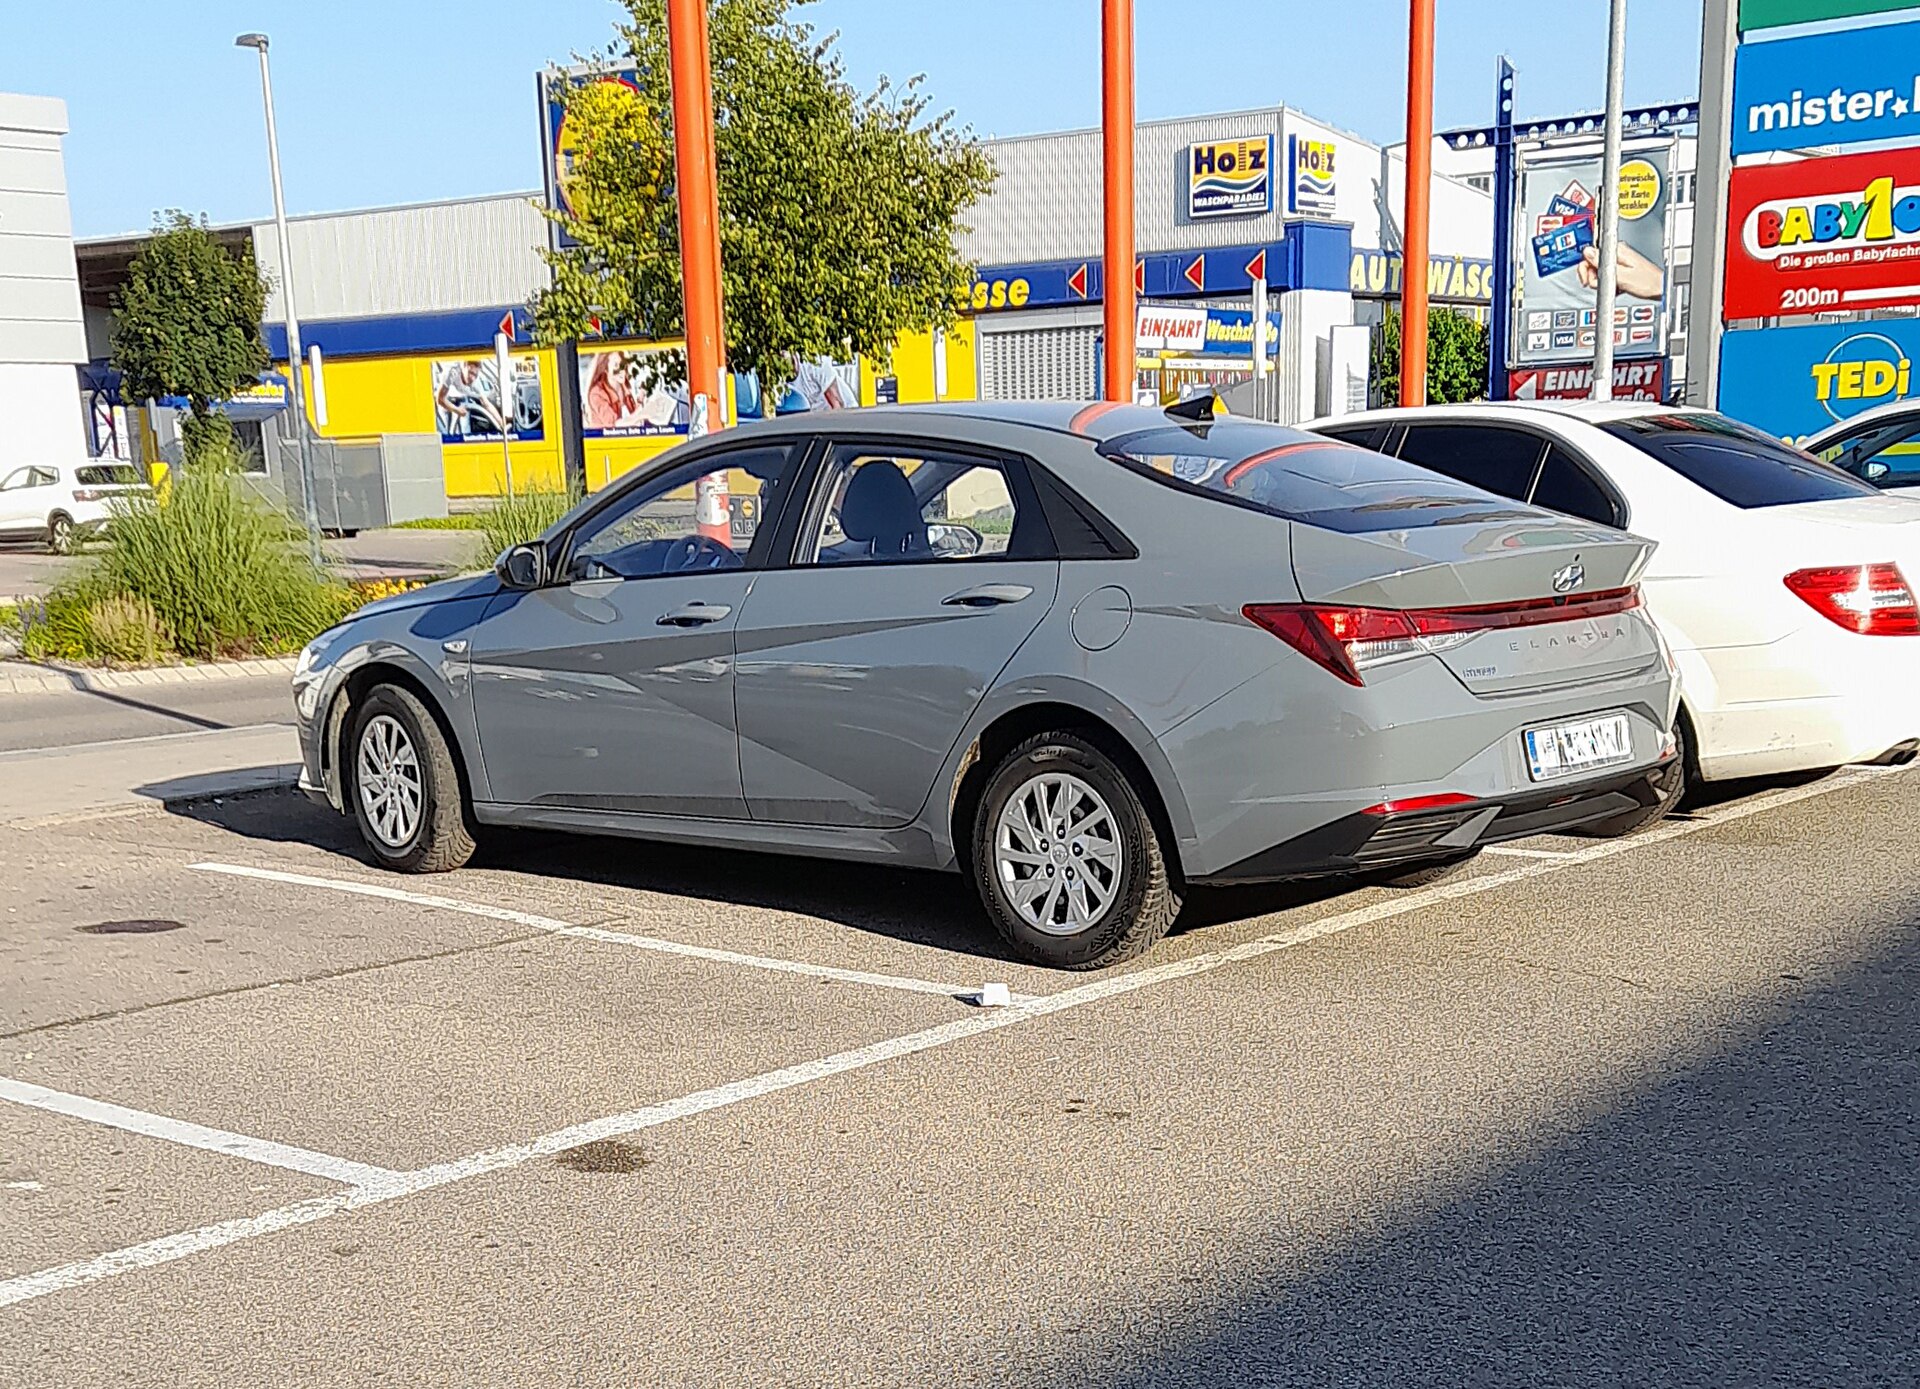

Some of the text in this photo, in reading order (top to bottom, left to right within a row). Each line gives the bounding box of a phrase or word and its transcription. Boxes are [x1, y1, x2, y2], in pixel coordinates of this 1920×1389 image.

[1194, 142, 1266, 175] Holz
[1299, 140, 1335, 172] Holz
[1780, 254, 1801, 269] Die
[1805, 250, 1850, 269] großen
[1780, 287, 1839, 309] 200m
[1139, 317, 1203, 338] EINFAHRT
[1544, 365, 1658, 391] EINFHRT
[1812, 358, 1911, 400] TEDi
[1509, 627, 1625, 651] ELANTRA
